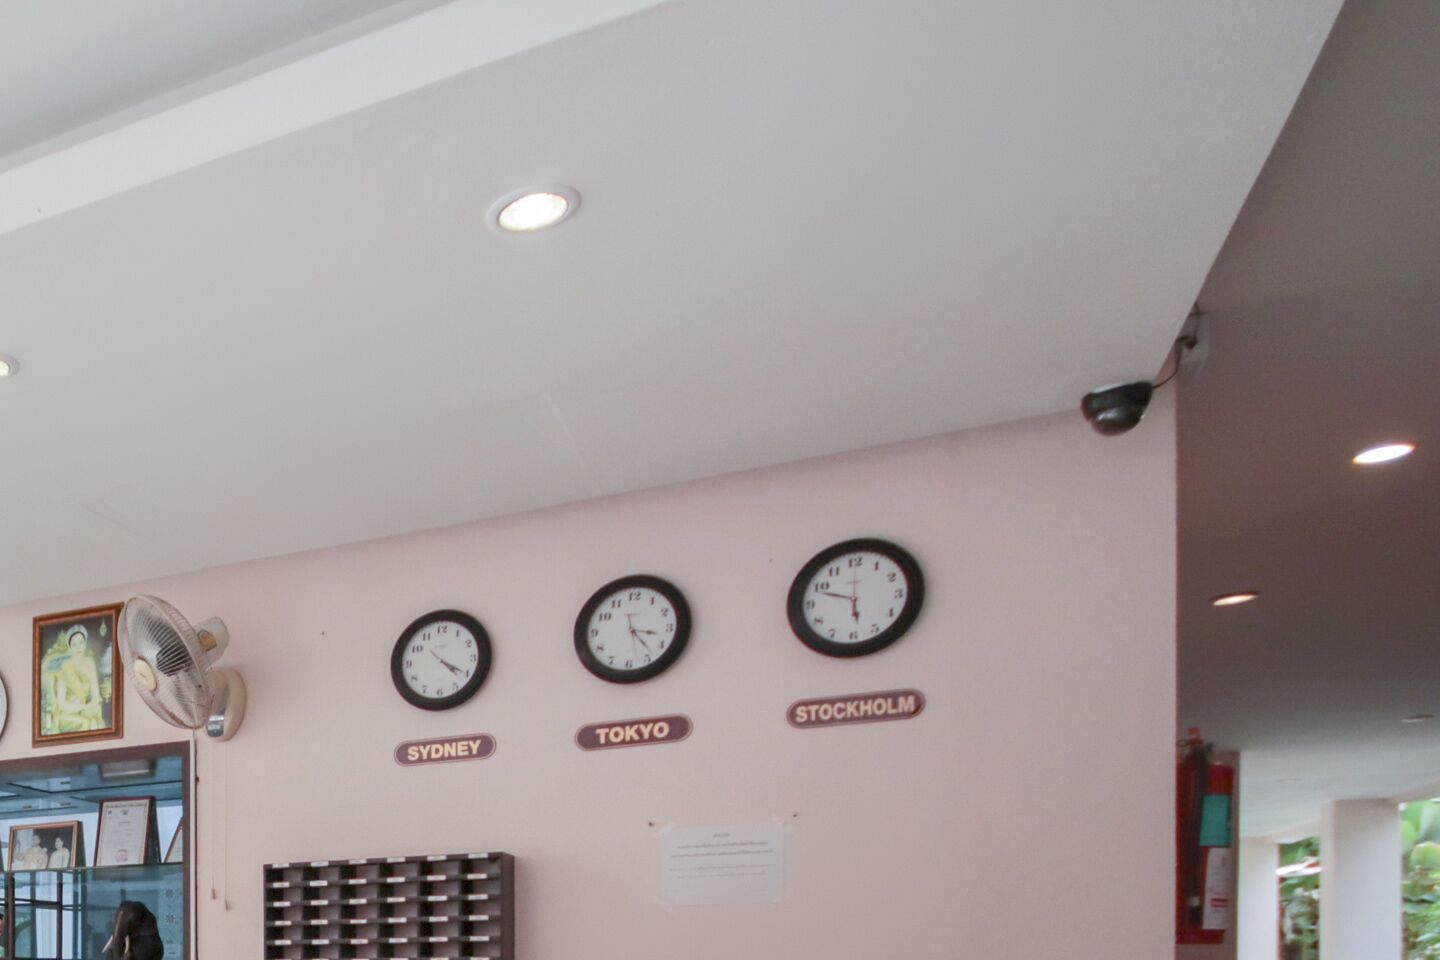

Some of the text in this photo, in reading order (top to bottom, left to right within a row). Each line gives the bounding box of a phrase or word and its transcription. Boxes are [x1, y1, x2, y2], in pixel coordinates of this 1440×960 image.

[848, 557, 862, 568] 12
[829, 567, 839, 576] 11
[815, 582, 829, 592] 10
[796, 695, 915, 722] STOCKHOLM
[595, 722, 669, 744] TOKYO
[408, 739, 481, 760] SYDNEY
